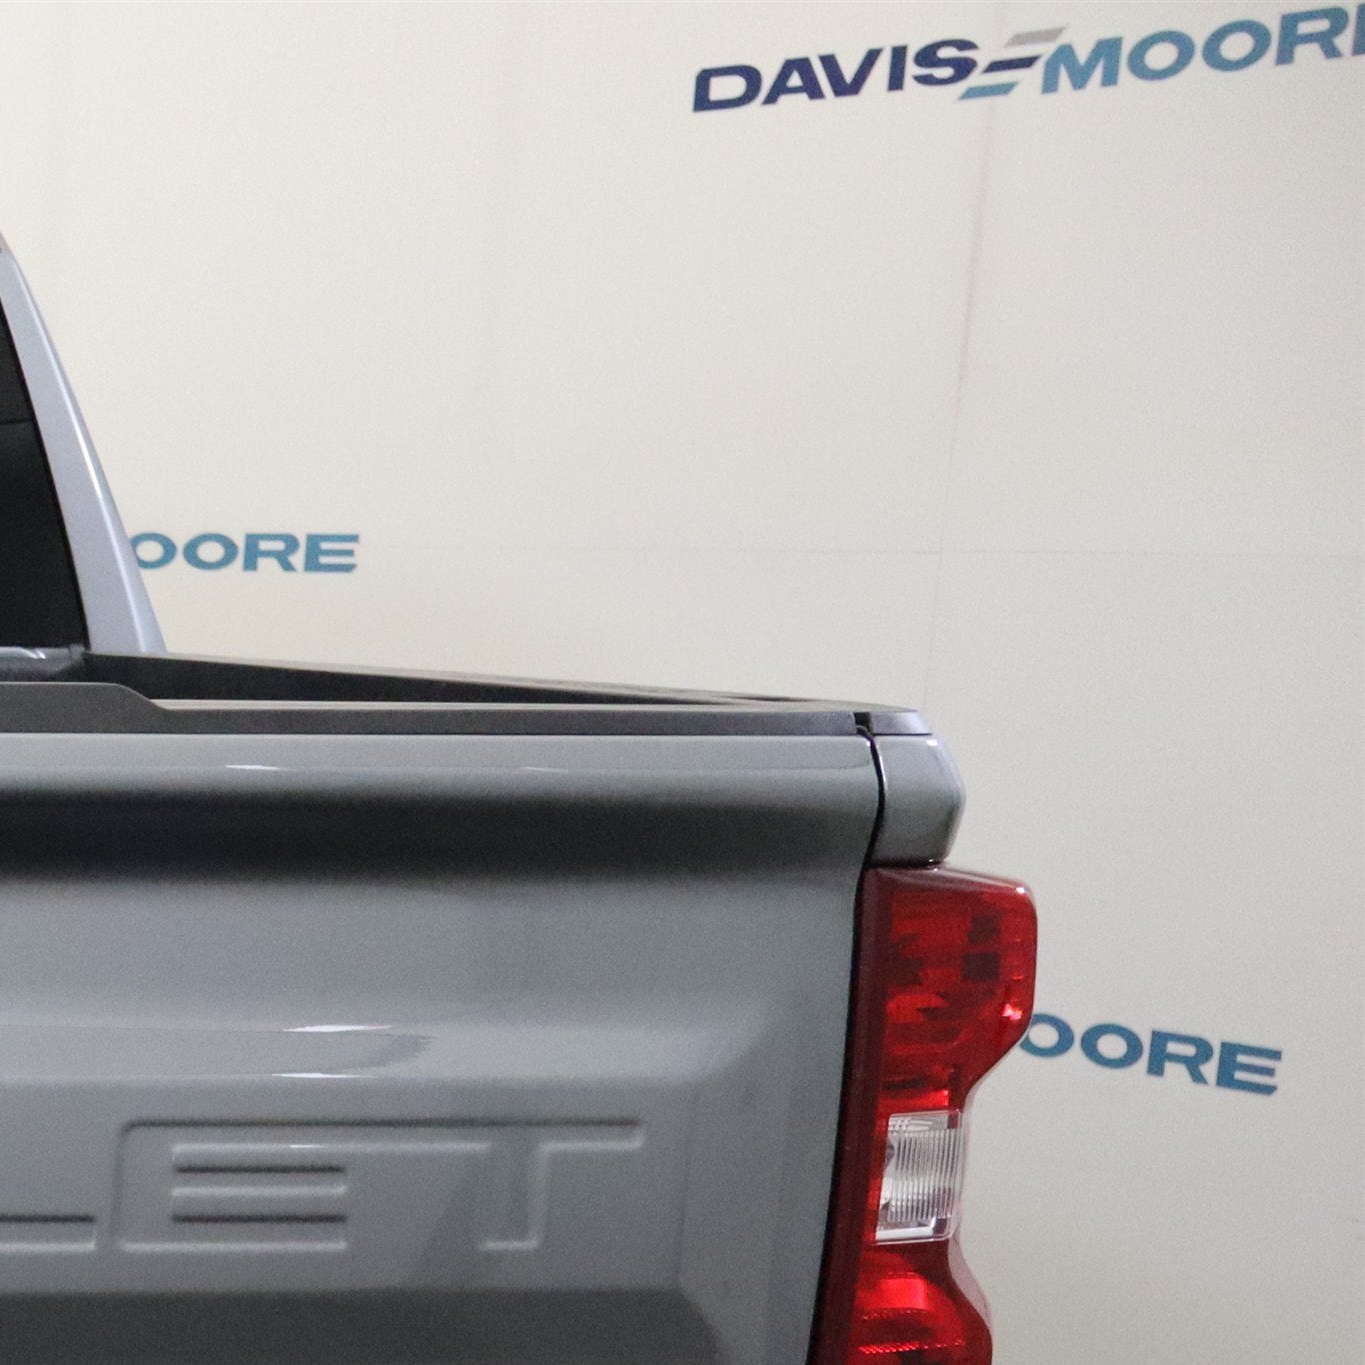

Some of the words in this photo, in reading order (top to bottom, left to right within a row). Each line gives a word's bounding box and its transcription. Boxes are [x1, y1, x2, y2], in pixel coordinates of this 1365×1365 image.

[692, 39, 979, 113] DAVIS
[1040, 3, 1365, 95] MOOR
[129, 532, 359, 573] OORE
[1019, 1013, 1283, 1097] OORE
